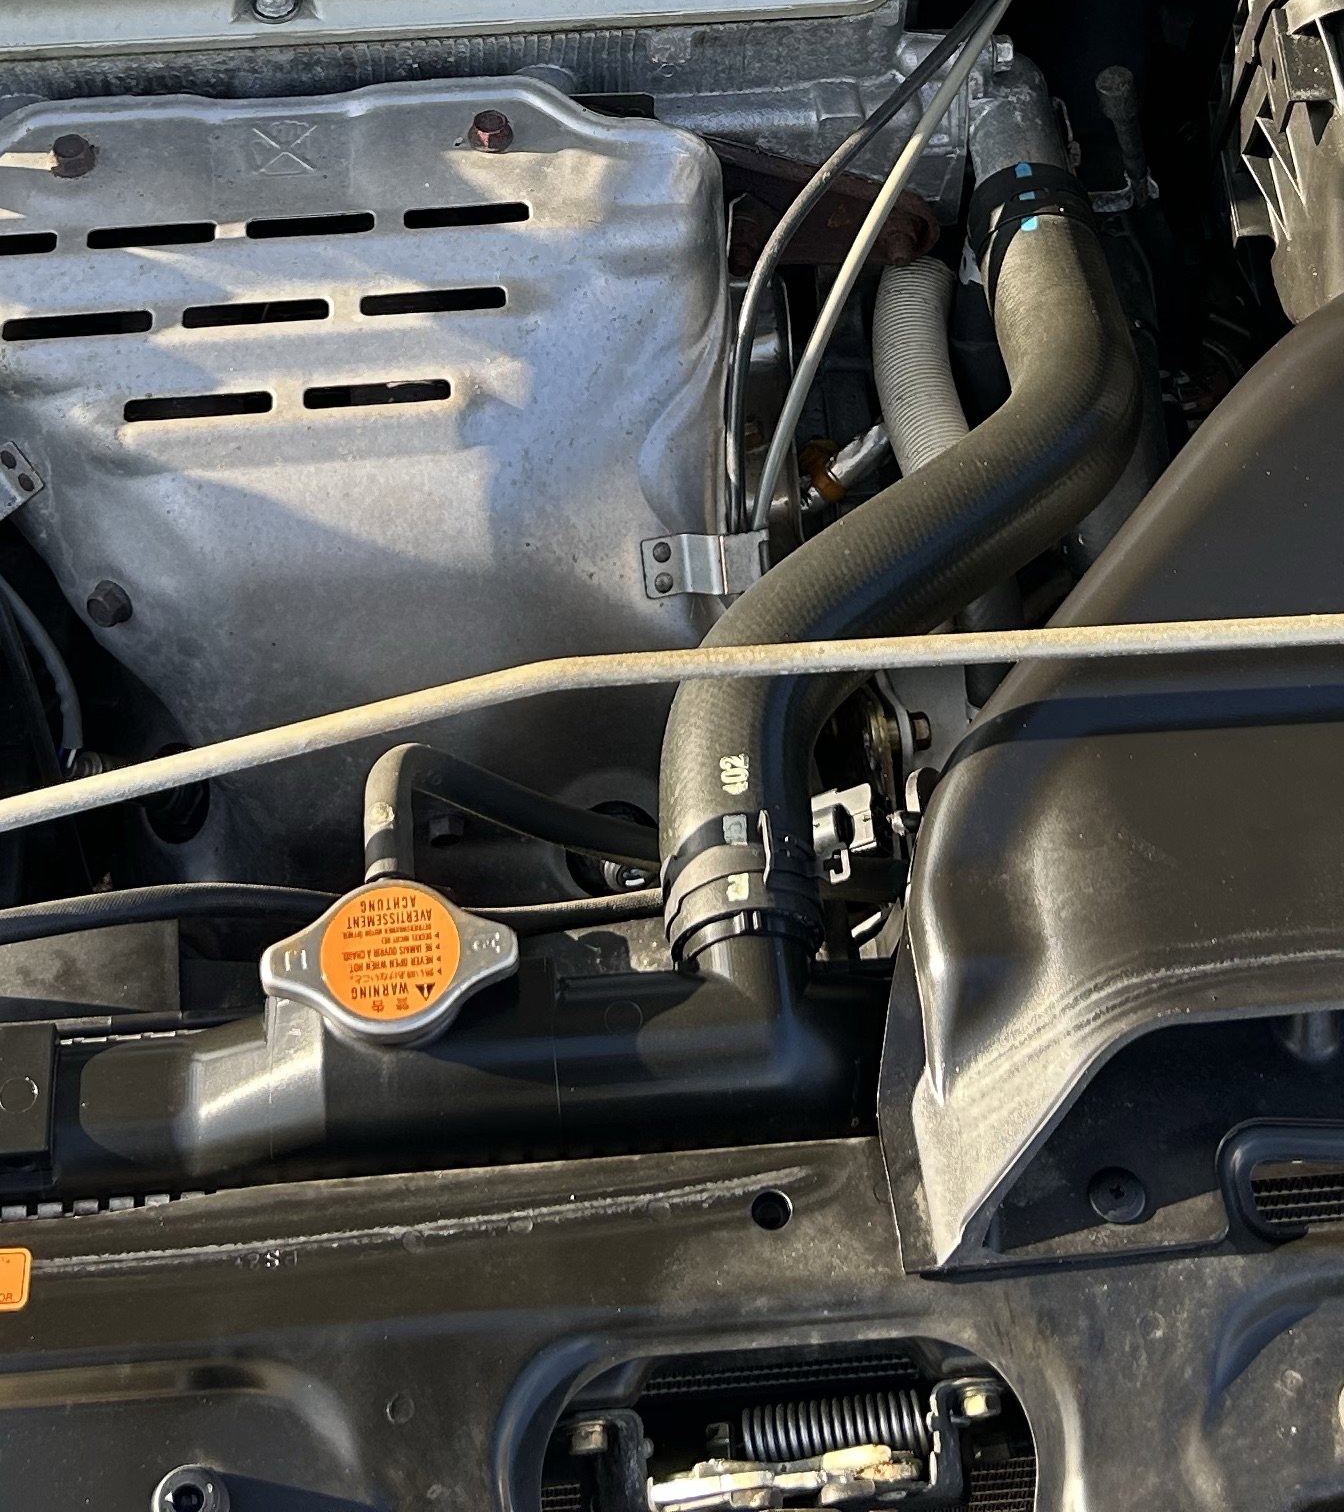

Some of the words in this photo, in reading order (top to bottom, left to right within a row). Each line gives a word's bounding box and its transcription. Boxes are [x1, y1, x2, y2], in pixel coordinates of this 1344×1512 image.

[359, 895, 417, 913] ACHTUNG
[346, 908, 433, 930] AVERTISSEMENT
[365, 959, 388, 970] WHEN
[389, 957, 409, 968] OPEN
[410, 955, 434, 966] NEVER
[350, 981, 409, 1000] WARNING
